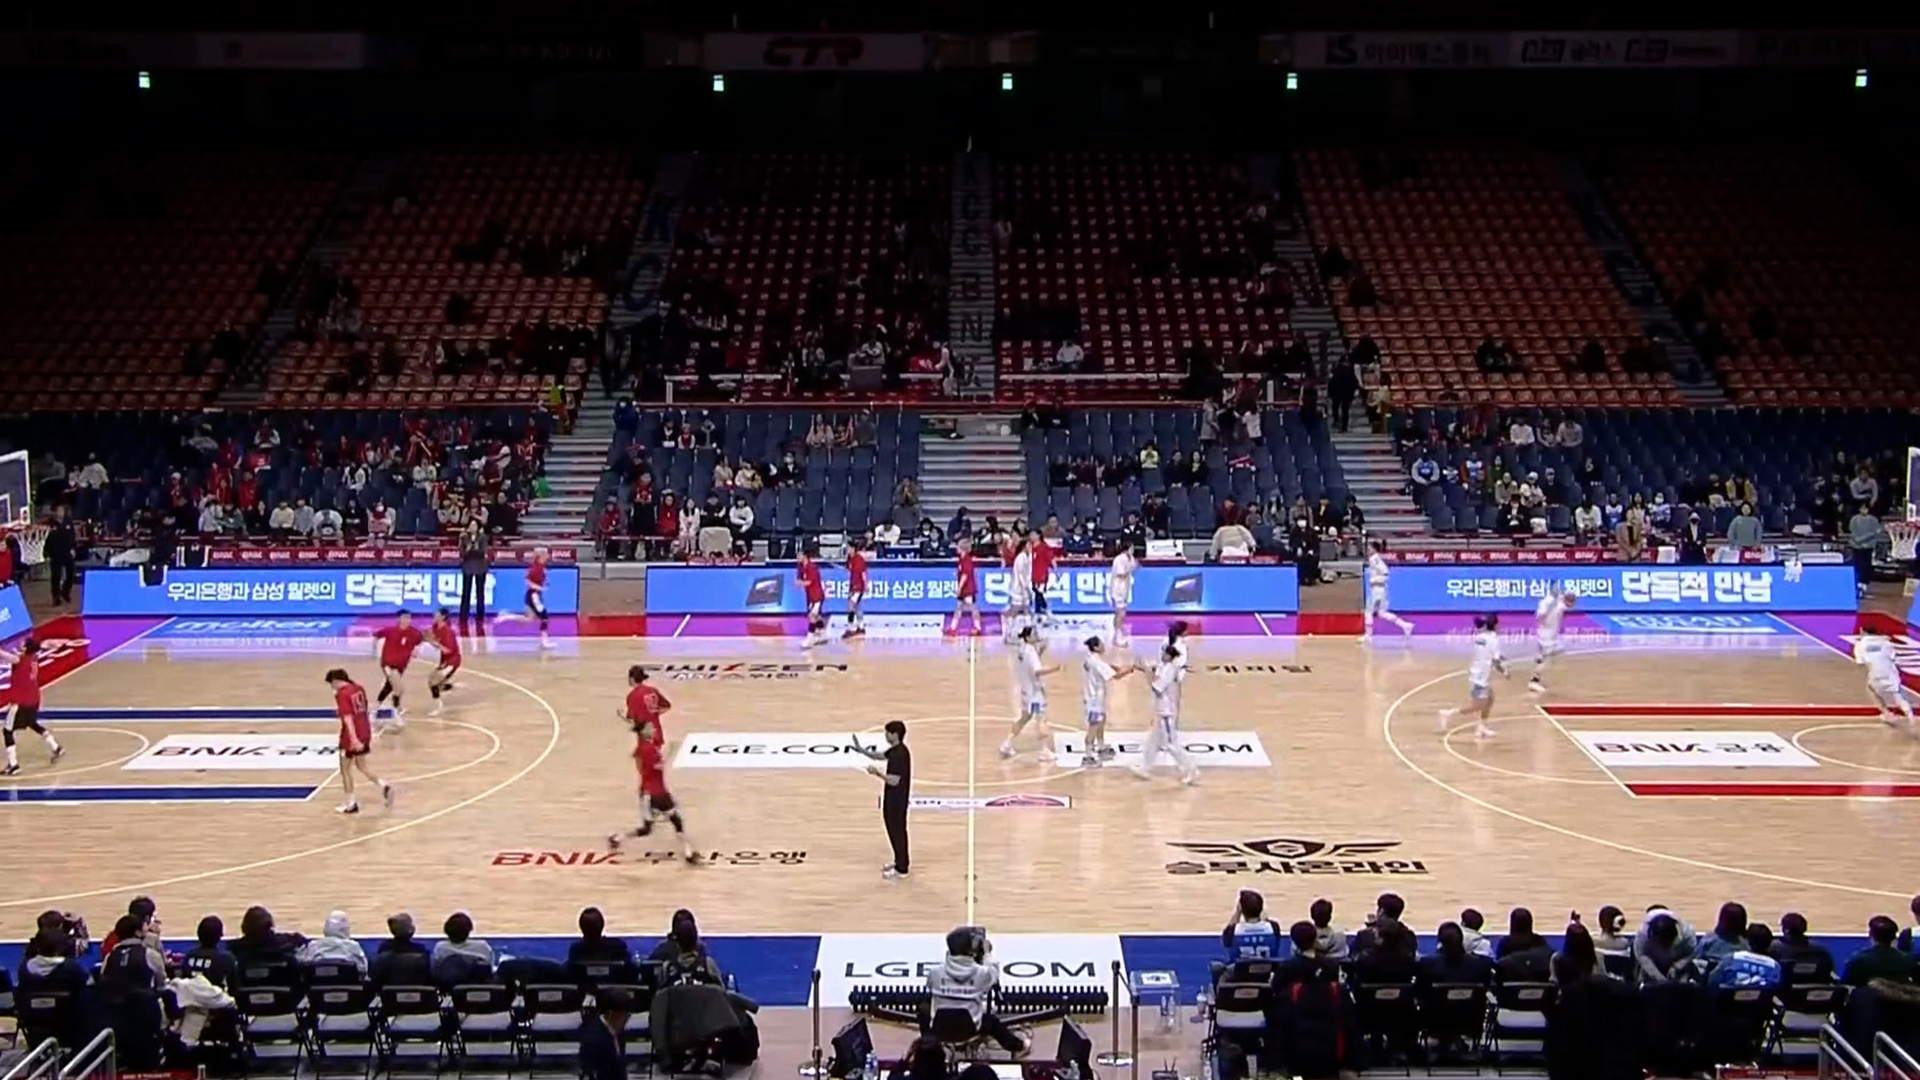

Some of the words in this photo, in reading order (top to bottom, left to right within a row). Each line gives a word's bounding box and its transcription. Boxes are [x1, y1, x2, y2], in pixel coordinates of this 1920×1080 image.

[167, 582, 250, 601] 우리은행과
[252, 582, 285, 601] 삼성
[287, 582, 336, 601] 월렛의
[437, 573, 497, 606] 만
[892, 580, 924, 599] 삼성
[927, 580, 959, 599] 월렛
[984, 572, 1071, 604] 단적
[1446, 579, 1527, 598] 우리은행과
[1713, 571, 1773, 603] 만남
[152, 746, 271, 757] BNK
[1065, 743, 1254, 754] LEOM
[1593, 742, 1711, 754] BNK
[491, 852, 623, 866] BNK
[844, 960, 1098, 979] LGEOM
